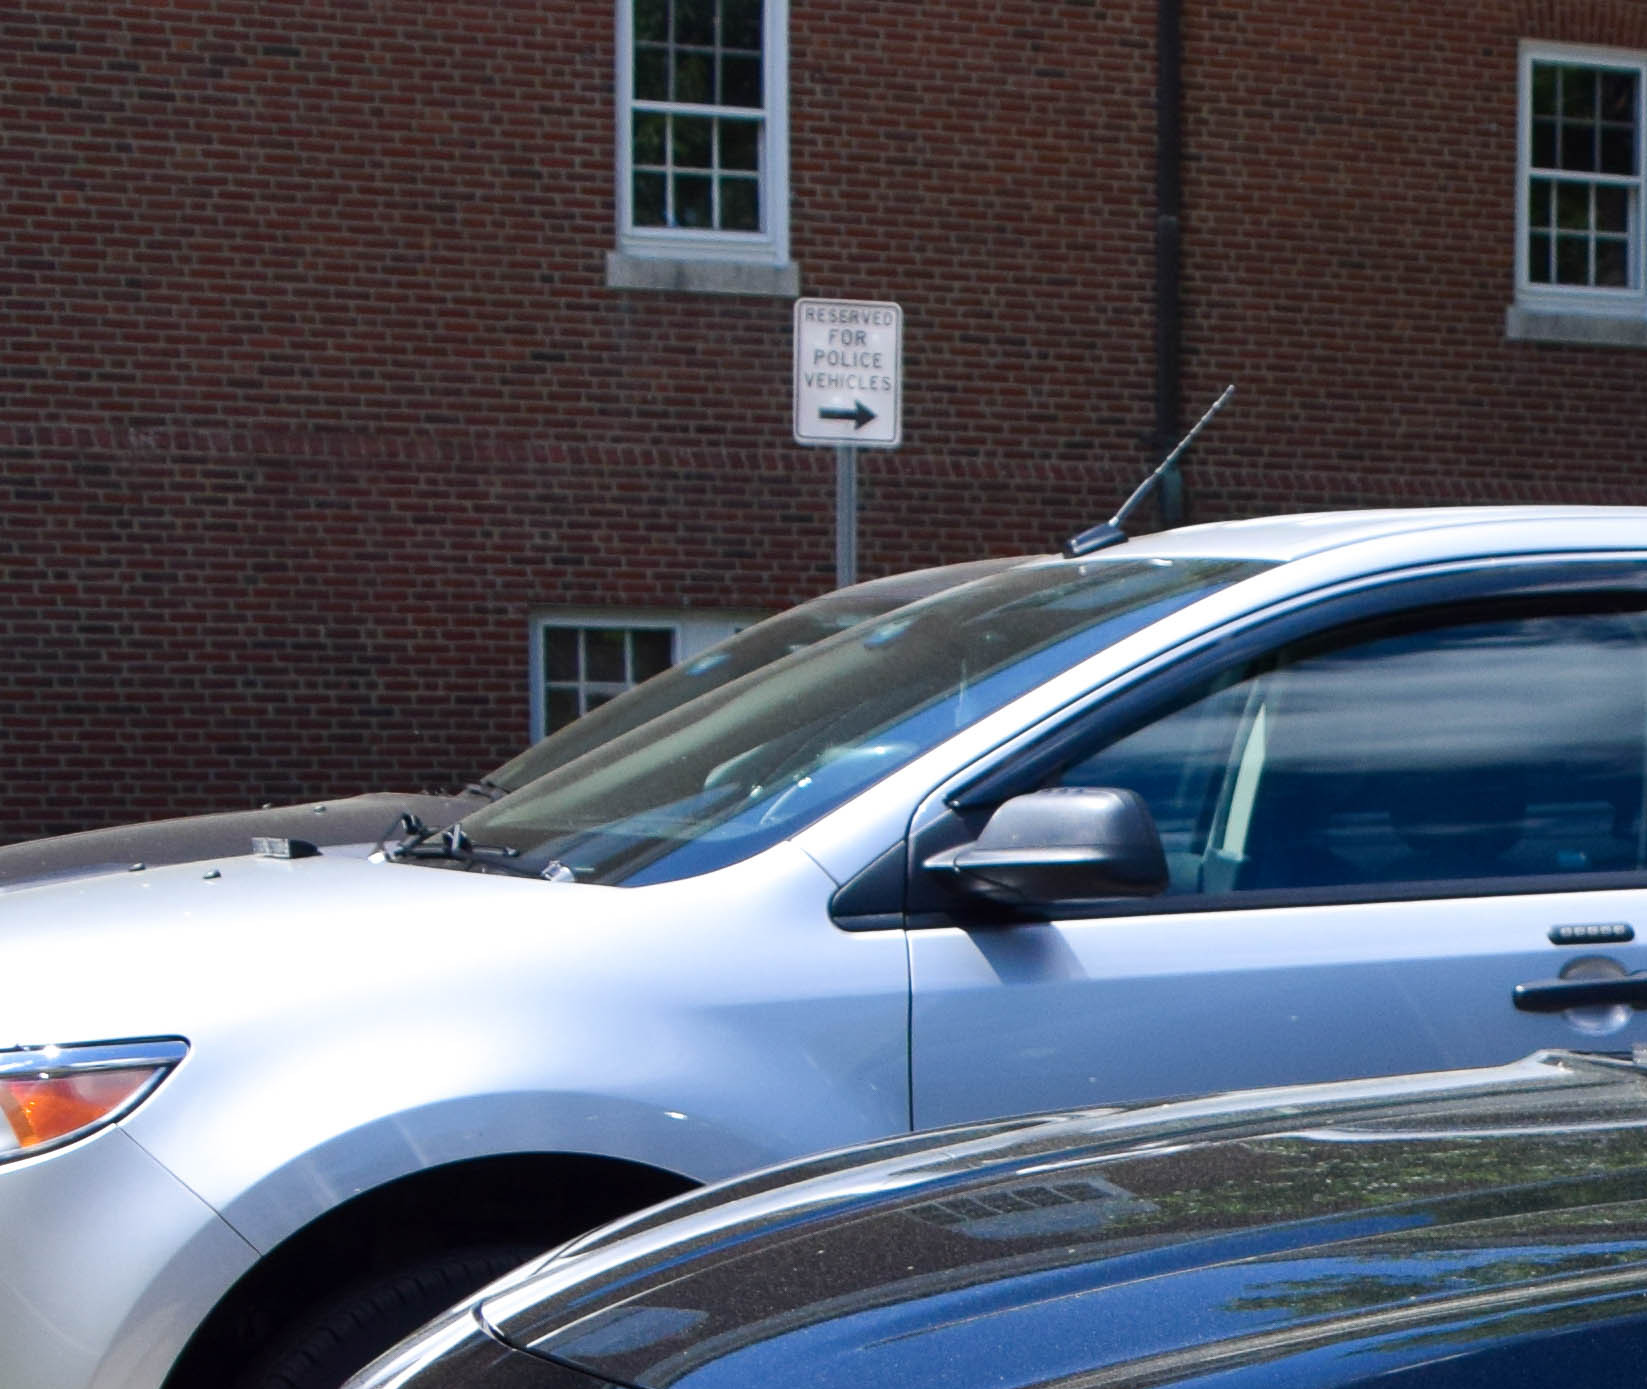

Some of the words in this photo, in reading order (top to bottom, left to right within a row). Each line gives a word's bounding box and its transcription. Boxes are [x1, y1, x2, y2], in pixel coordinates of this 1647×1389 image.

[804, 307, 894, 326] RESERVED
[828, 328, 867, 346] FOR
[813, 348, 883, 369] POLICE
[804, 372, 892, 391] VEHICLES
